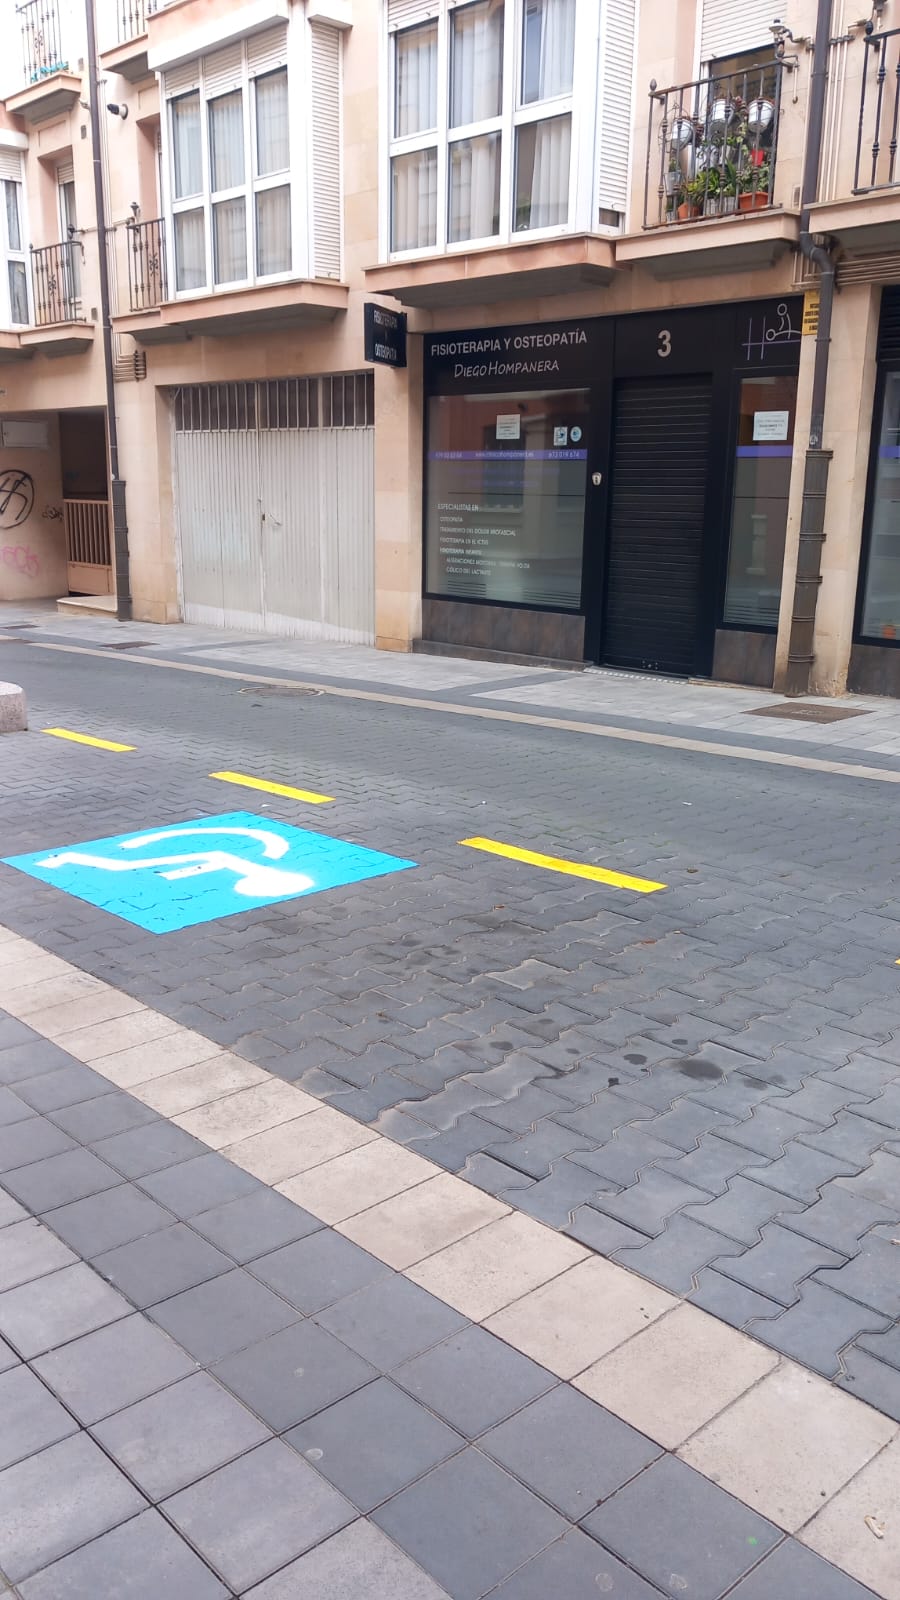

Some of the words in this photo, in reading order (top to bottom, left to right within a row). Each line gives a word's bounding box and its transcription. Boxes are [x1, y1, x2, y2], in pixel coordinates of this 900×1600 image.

[431, 339, 501, 356] FISIOTERAPIA
[504, 337, 511, 350] Y
[513, 328, 588, 349] OSTEOPATÍA
[657, 329, 672, 358] 3
